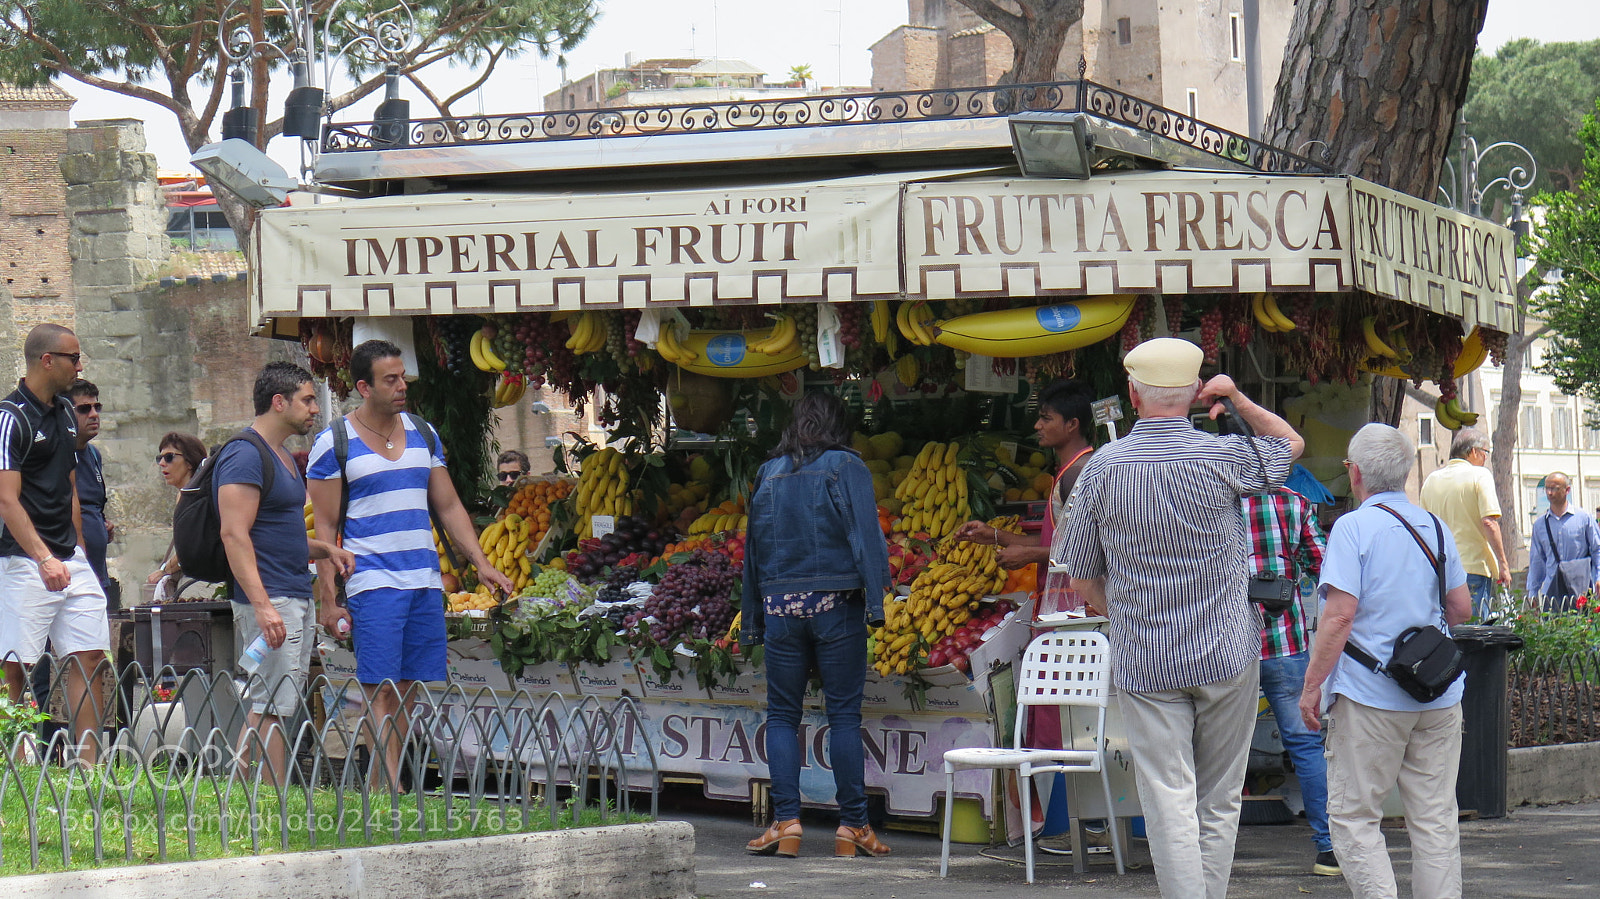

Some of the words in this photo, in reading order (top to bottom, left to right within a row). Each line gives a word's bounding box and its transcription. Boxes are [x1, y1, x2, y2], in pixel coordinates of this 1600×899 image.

[703, 199, 730, 215] AI
[742, 196, 807, 214] FORI
[917, 192, 1136, 257] FRUTTA
[1140, 189, 1343, 252] FRESCA
[343, 227, 618, 278] IMPERIAL
[631, 221, 808, 267] FRUIT
[1355, 189, 1434, 274] FRUTTA
[1436, 216, 1514, 296] FRESCA
[450, 671, 486, 682] Melinda
[515, 674, 551, 685] Melinda
[579, 676, 617, 687] Melinda
[645, 680, 682, 691] Melinda
